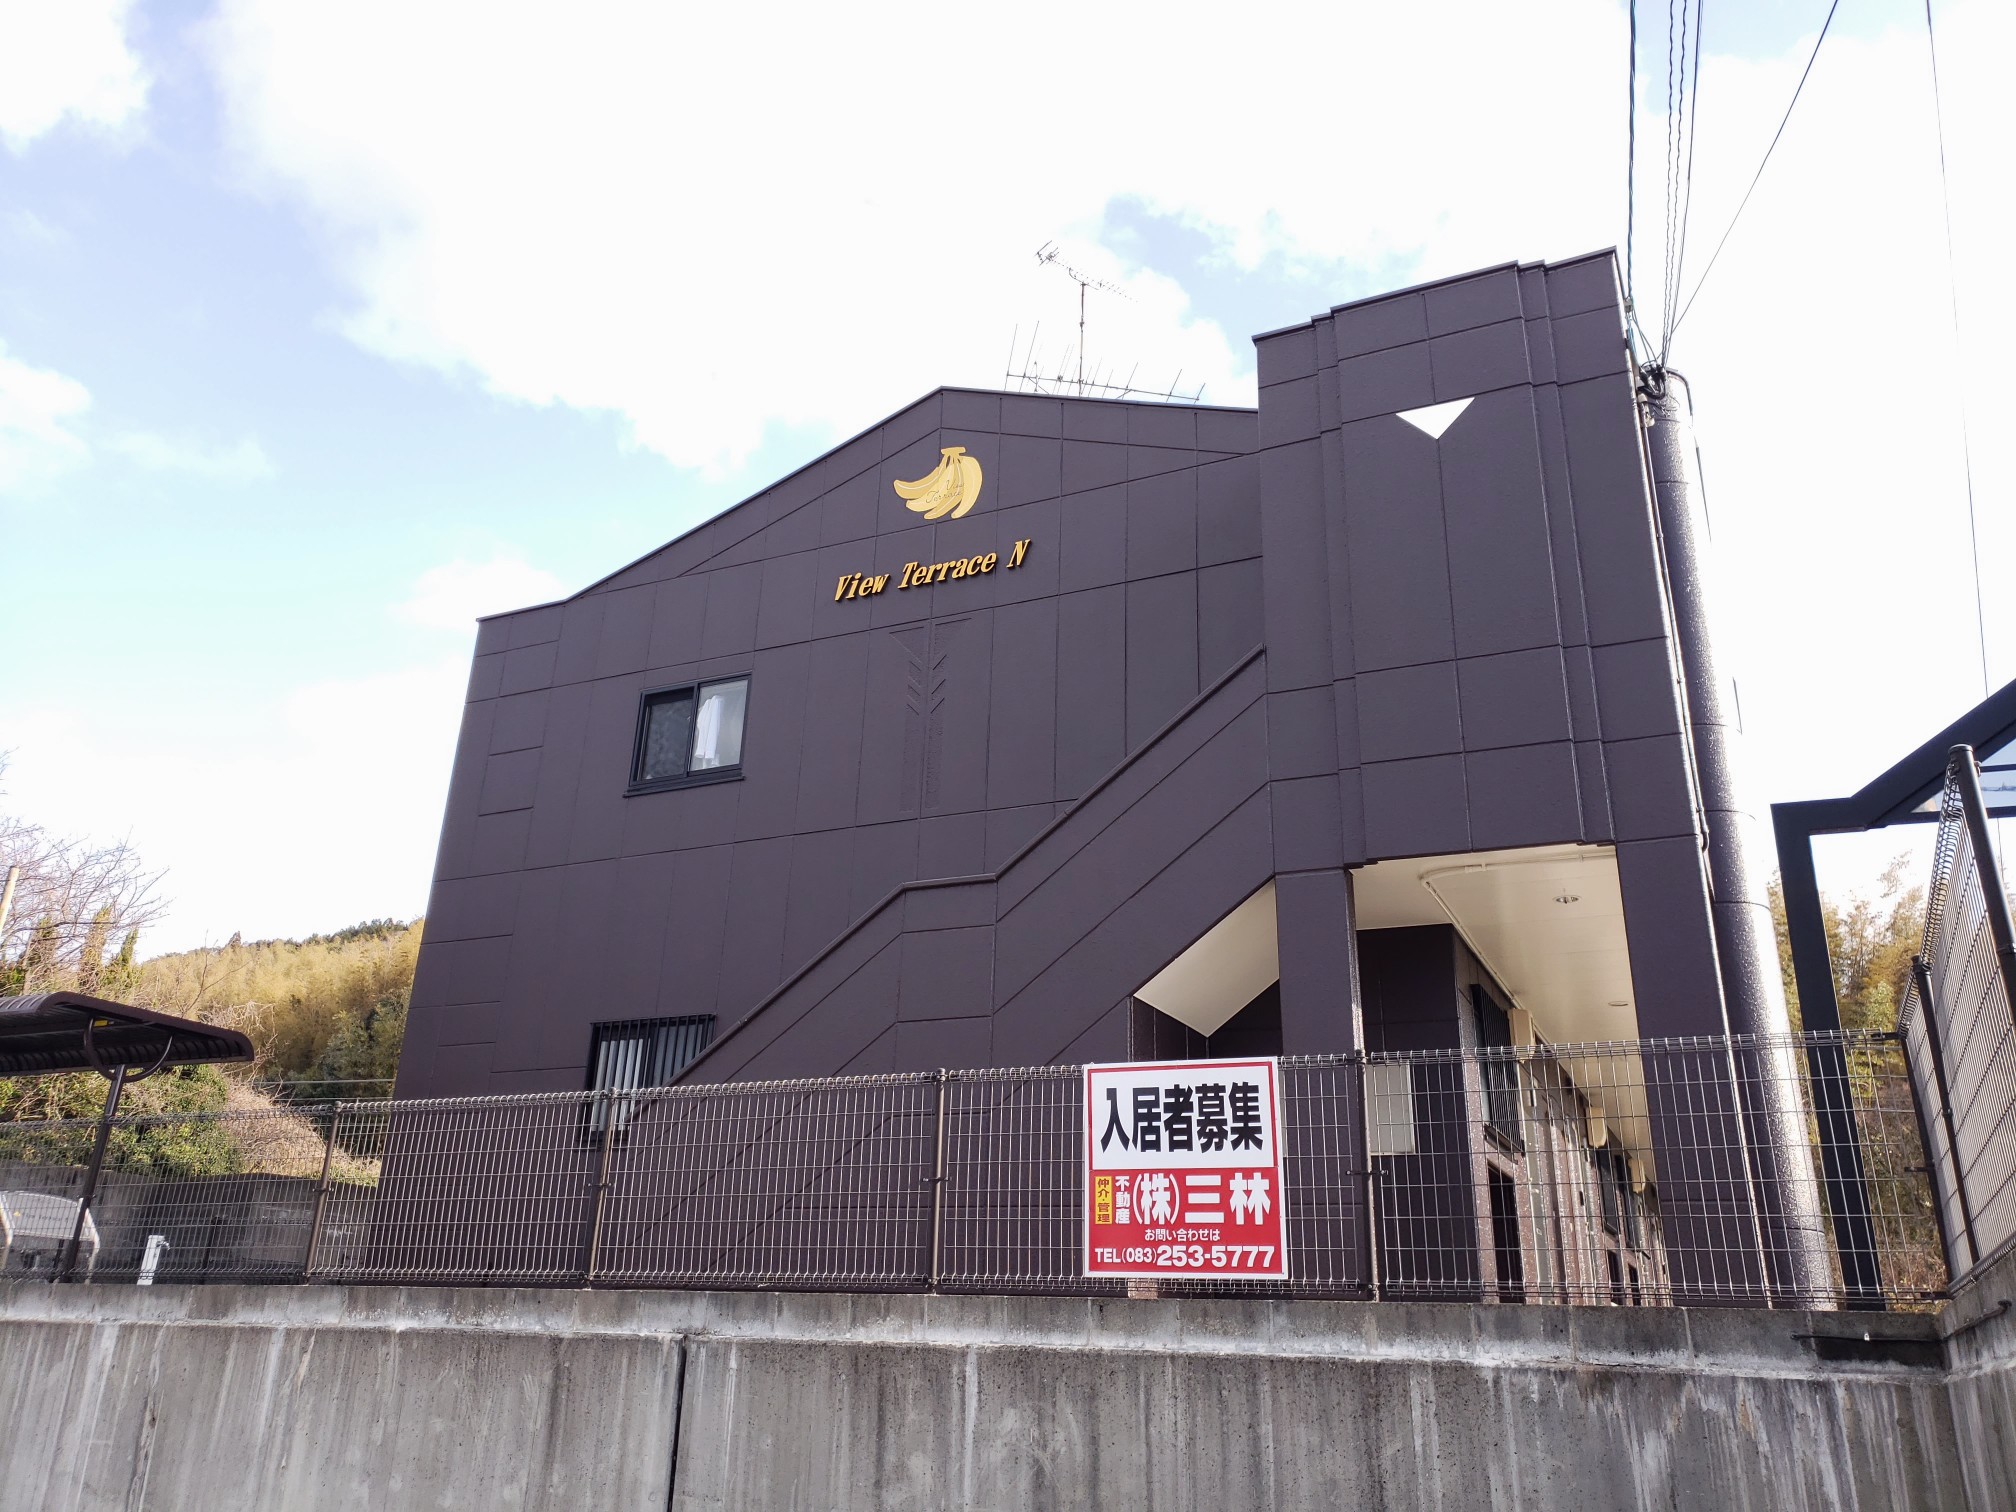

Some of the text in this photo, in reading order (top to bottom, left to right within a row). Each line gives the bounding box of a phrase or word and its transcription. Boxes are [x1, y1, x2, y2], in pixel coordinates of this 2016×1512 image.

[834, 538, 1032, 602] View Terrace N
[1100, 1081, 1264, 1154] 入居者募集
[1114, 1175, 1131, 1224] 不動産
[1144, 1228, 1221, 1242] お問い合わせは
